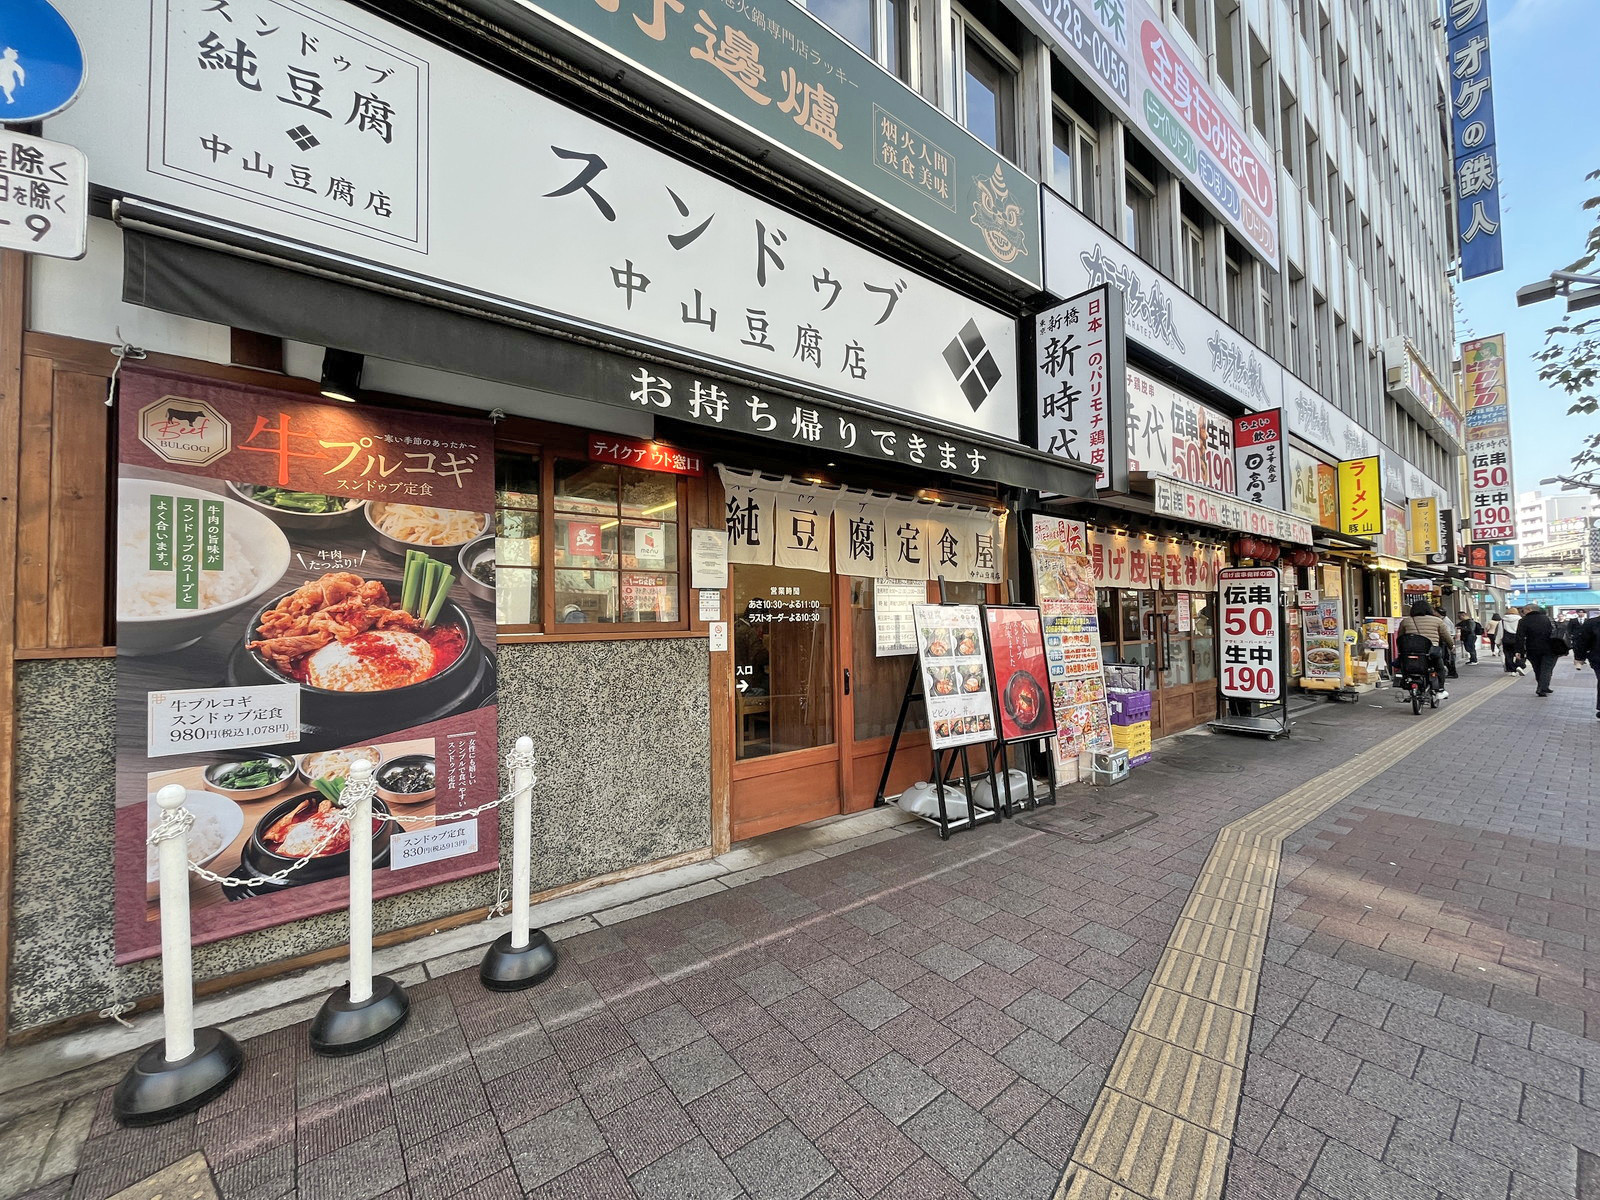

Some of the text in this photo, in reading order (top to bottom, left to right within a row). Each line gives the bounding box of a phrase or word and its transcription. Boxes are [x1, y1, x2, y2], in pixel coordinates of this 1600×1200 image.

[201, 0, 395, 84] スンドゥブ
[197, 30, 396, 145] 純豆腐
[1145, 92, 1197, 169] ドライヘッドスパ
[1150, 37, 1268, 208] 全身もみほぐし
[200, 133, 393, 219] 中山豆腐店
[541, 144, 908, 327] スンドゥブ
[609, 258, 867, 381] 中山豆腐店
[1047, 305, 1081, 333] 新橋
[1039, 333, 1083, 462] 新時代
[151, 418, 210, 441] Beef
[629, 367, 989, 474] お持ち帰りできます
[1170, 400, 1199, 441] 伝串
[1206, 419, 1231, 455] 生中
[1239, 418, 1270, 432] ちょい
[160, 440, 210, 453] BULGOGI
[1252, 429, 1278, 444] 飲み
[593, 441, 700, 472] テイクアウト窓口
[1472, 451, 1507, 469] 伝串
[336, 479, 434, 497] スンドゥブ定食
[1349, 461, 1369, 521] ラーメン
[1474, 491, 1509, 508] 生中
[156, 501, 169, 566] よく合います。
[207, 505, 220, 563] 牛肉の旨味が
[726, 495, 996, 570] 純豆腐定食屋
[1348, 522, 1373, 533] 豚山
[182, 504, 195, 603] スンドゥブのスープと
[317, 550, 343, 561] 牛肉
[770, 586, 801, 596] 営業時間
[1223, 584, 1272, 606] 伝串
[748, 612, 820, 623] ラストオーダーよる10:30
[1225, 645, 1273, 666] 生中
[736, 665, 754, 676] 入口
[170, 695, 253, 713] 牛プルコギ
[171, 706, 284, 727] スンドゥブ定食
[447, 741, 456, 790] スンドゥブ定食
[458, 740, 467, 808] シンプルで食べやすい
[404, 827, 466, 848] スンドゥブ定食
